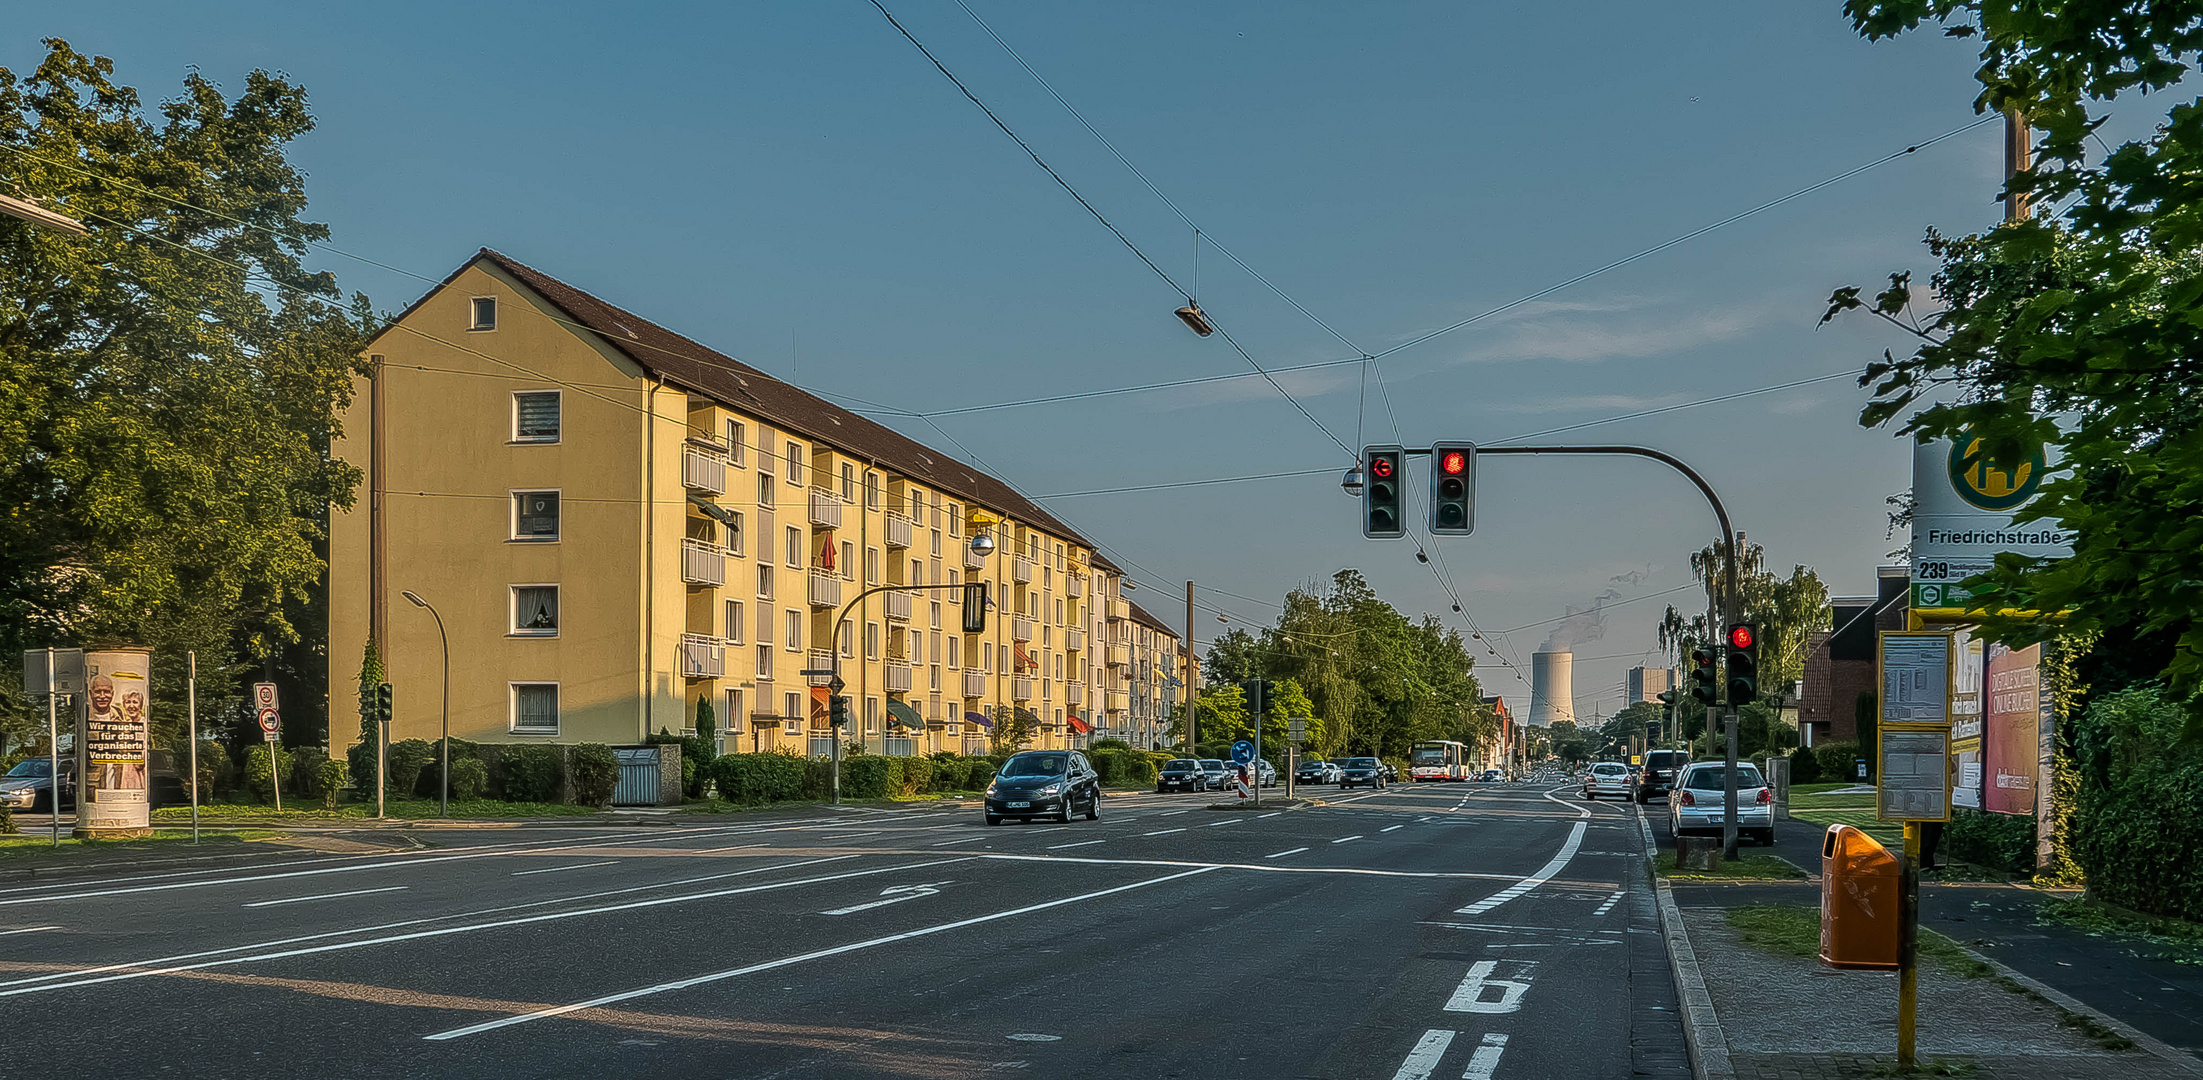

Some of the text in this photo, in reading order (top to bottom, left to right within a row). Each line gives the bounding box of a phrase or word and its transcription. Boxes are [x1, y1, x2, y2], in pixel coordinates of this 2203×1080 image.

[1928, 529, 2062, 545] Friedrichstraße
[1919, 561, 1948, 579] 239
[262, 690, 270, 699] 30
[89, 722, 143, 731] Wir rauchen
[100, 731, 135, 740] für das
[88, 741, 143, 751] organisierte
[89, 751, 143, 760] Verbrechen
